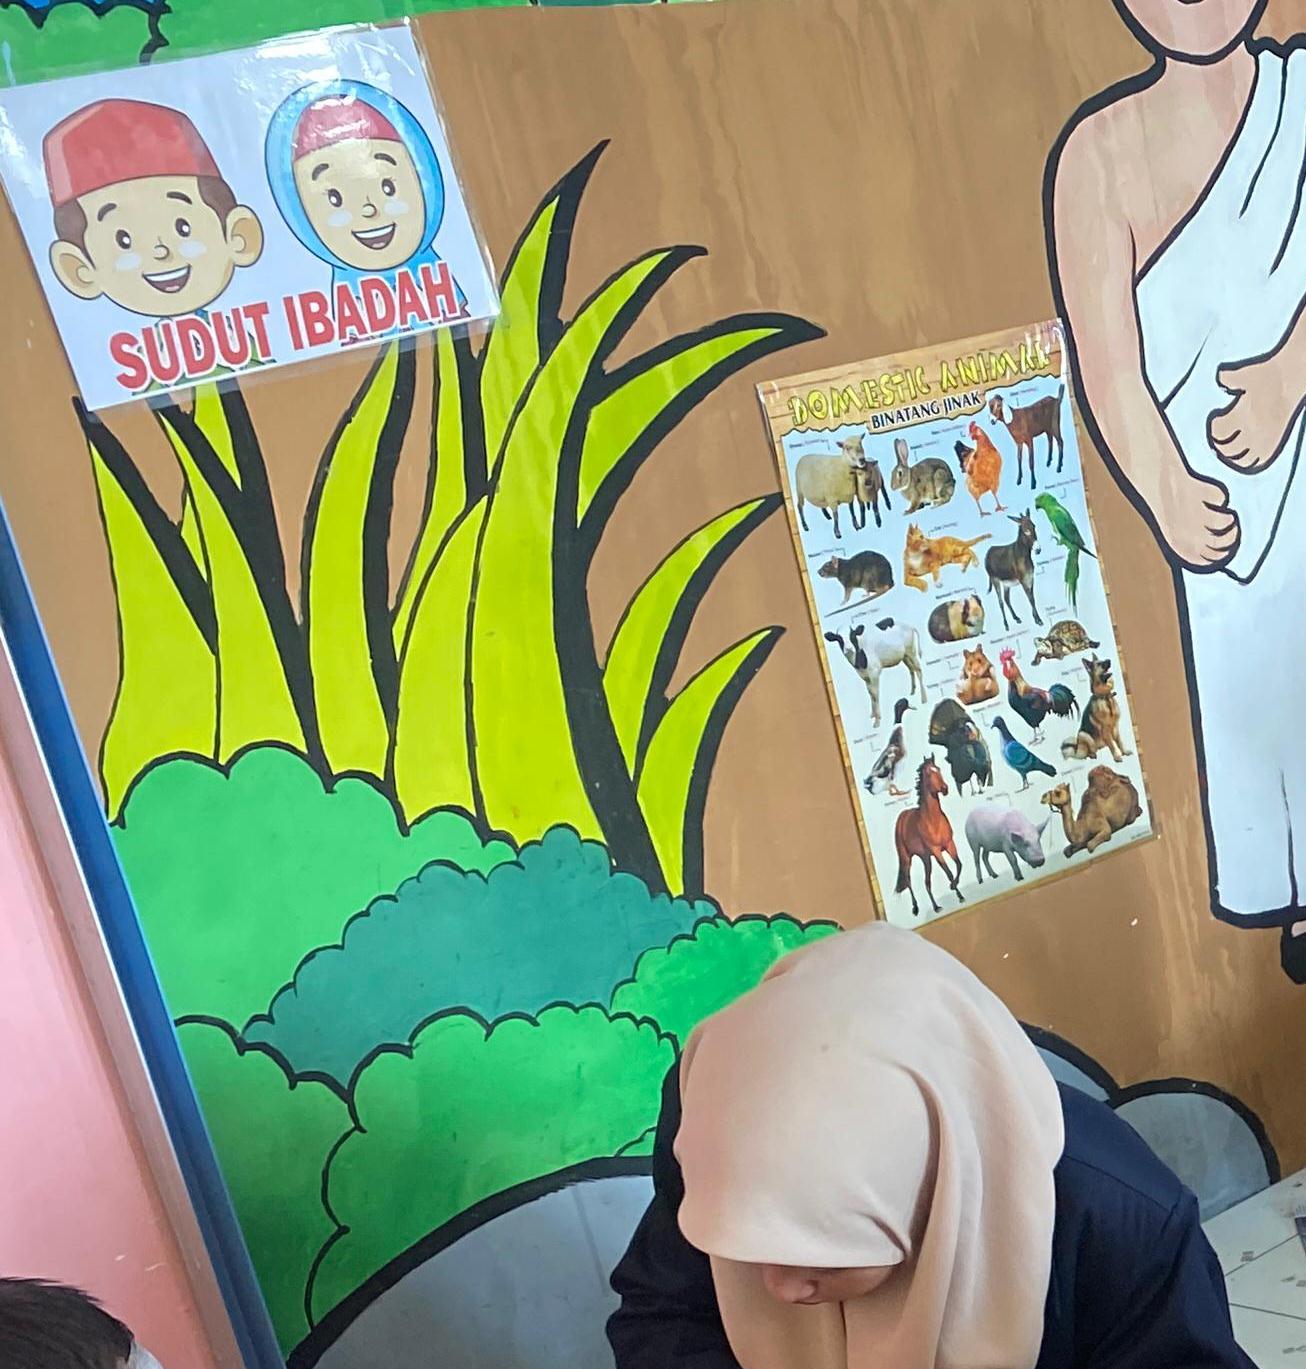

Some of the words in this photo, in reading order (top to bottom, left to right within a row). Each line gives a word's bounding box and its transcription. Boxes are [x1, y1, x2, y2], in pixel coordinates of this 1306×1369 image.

[109, 302, 271, 389] SUDUT
[282, 262, 458, 351] IBADAH
[789, 366, 930, 425] DOMESTIC
[939, 339, 1050, 393] ANIMAL
[871, 400, 941, 430] BINATANG
[943, 391, 981, 418] JINAK
